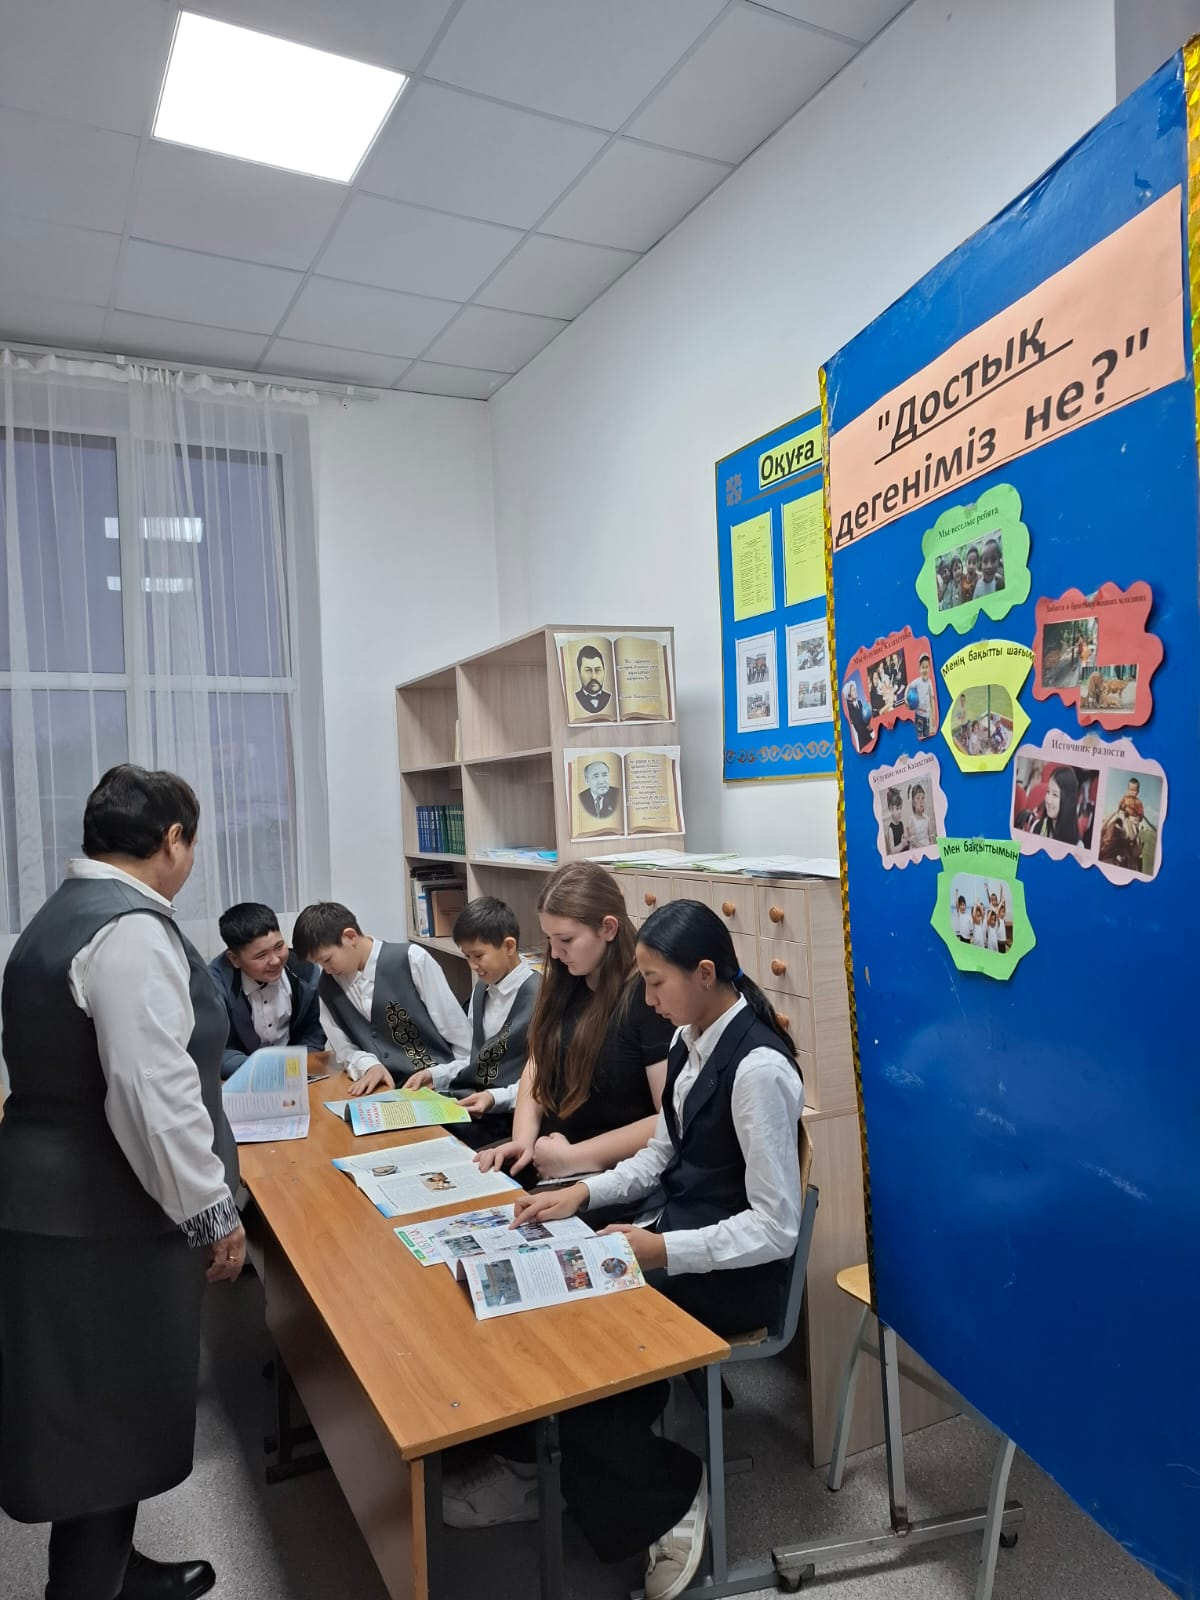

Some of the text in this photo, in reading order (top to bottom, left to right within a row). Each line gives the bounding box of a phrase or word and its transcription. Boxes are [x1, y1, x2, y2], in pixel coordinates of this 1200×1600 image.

[877, 317, 1046, 453] "Достық
[835, 426, 997, 549] дегеніміз
[1024, 326, 1150, 441] не?"
[761, 439, 815, 481] Оқуға
[938, 506, 1000, 539] Мы веселые ребята
[942, 655, 966, 678] Менің
[968, 647, 1004, 662] бақытты
[1051, 738, 1126, 759] Источник радости
[943, 840, 1019, 862] Мен бақыттымын
